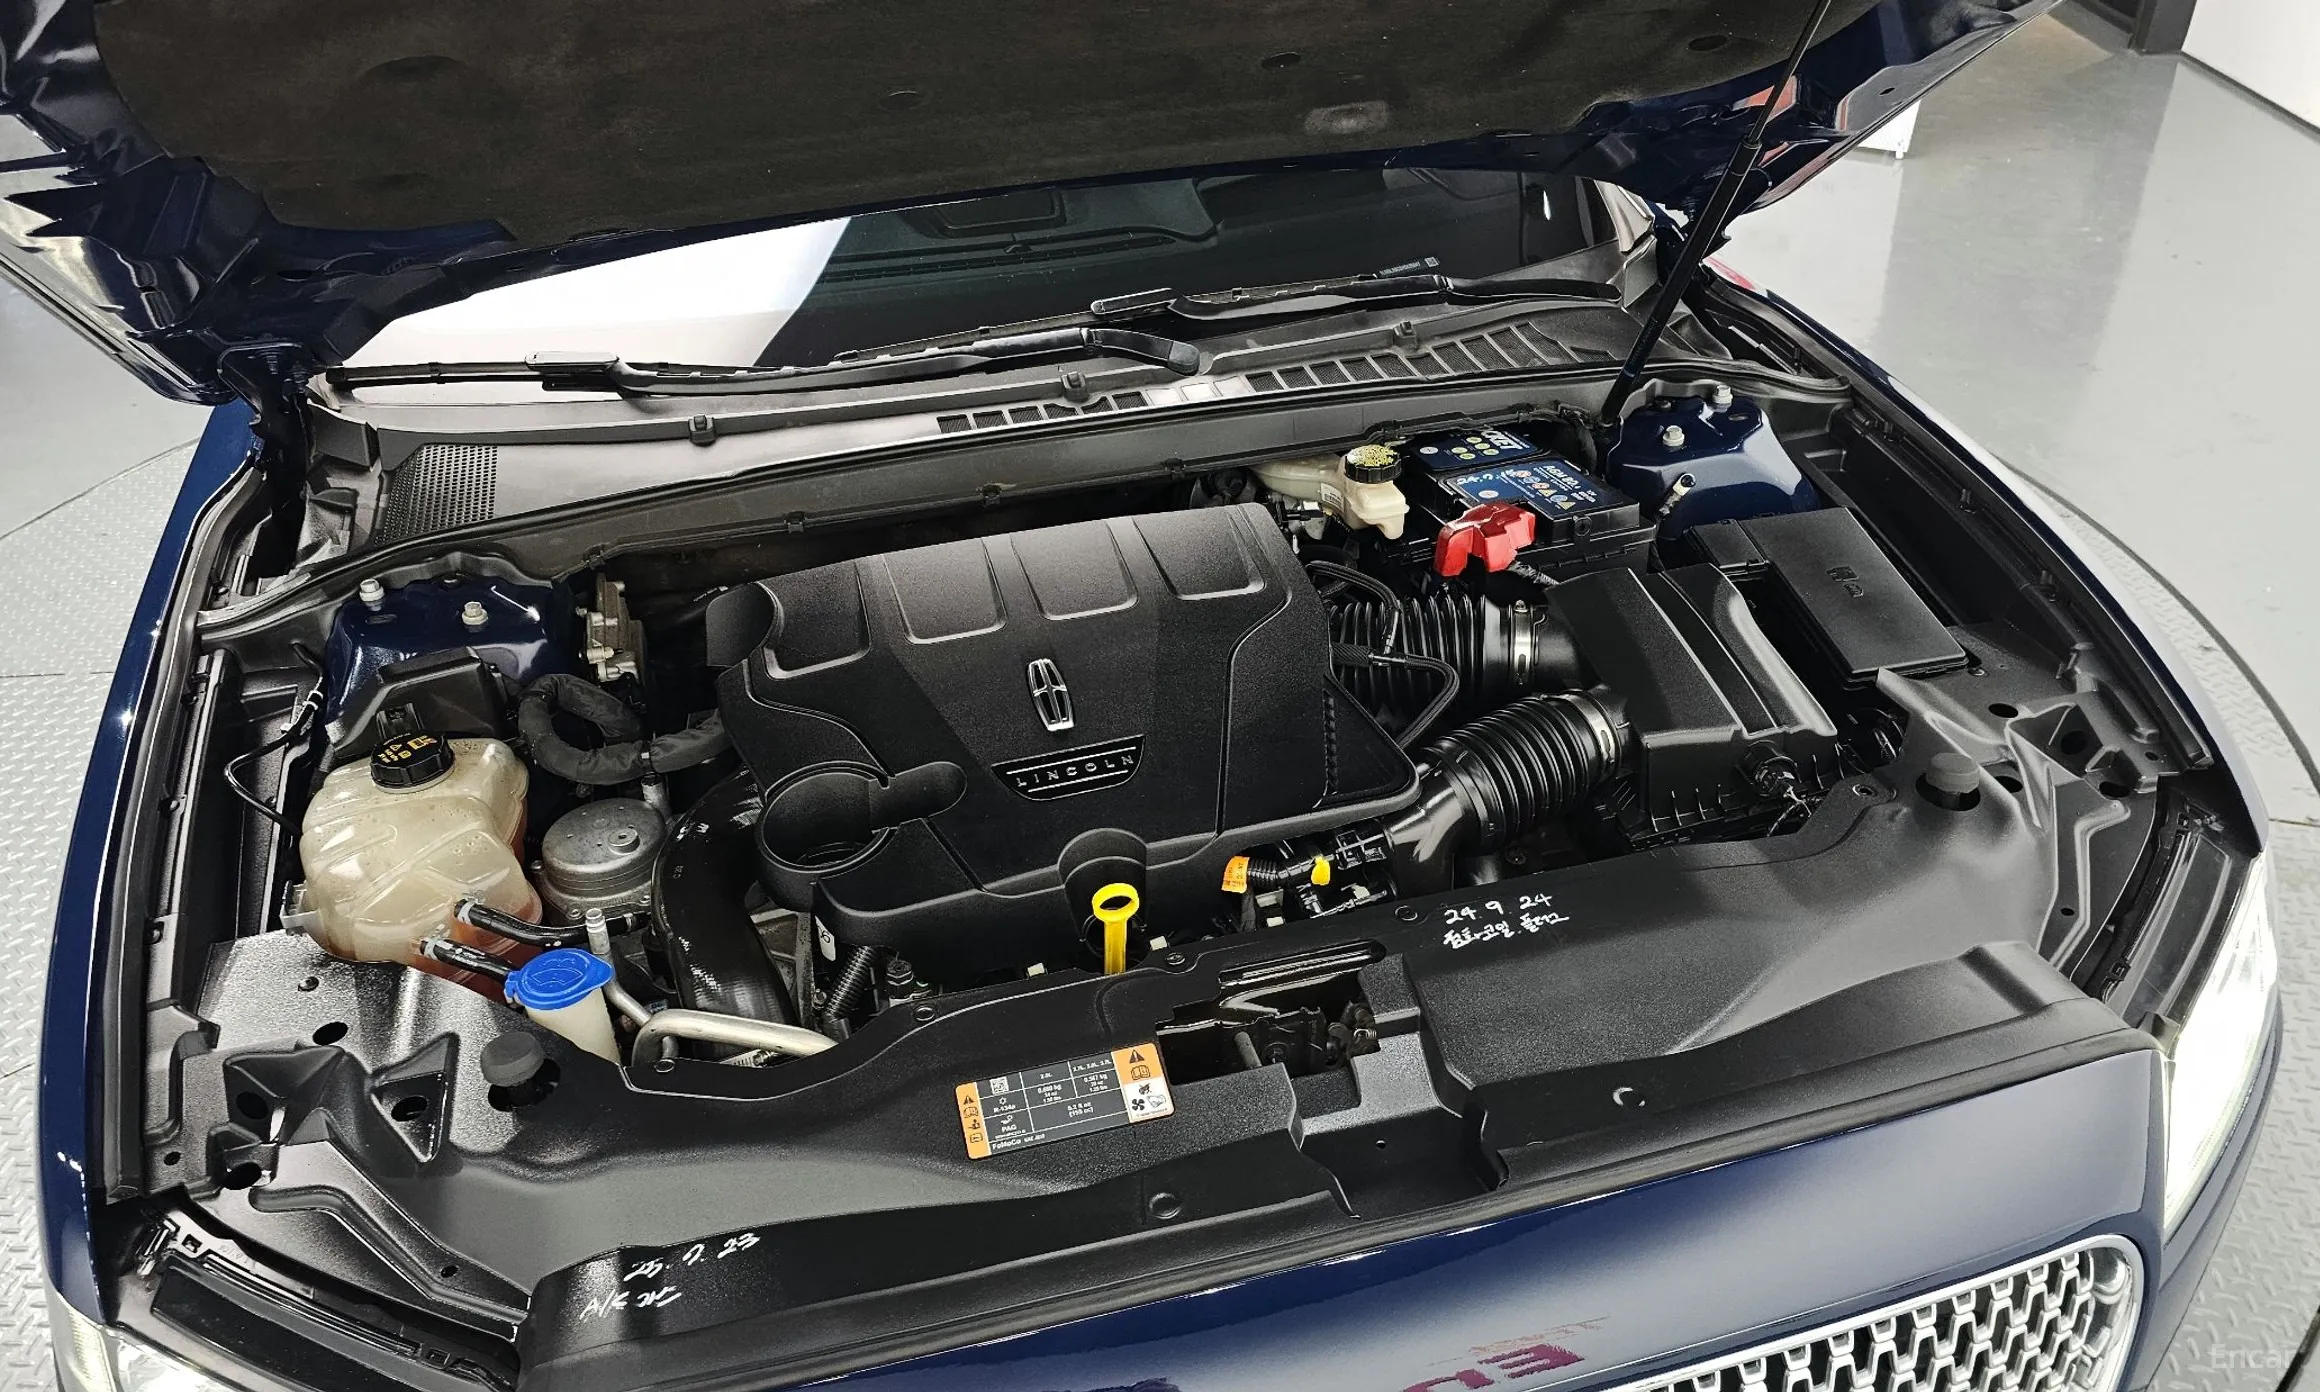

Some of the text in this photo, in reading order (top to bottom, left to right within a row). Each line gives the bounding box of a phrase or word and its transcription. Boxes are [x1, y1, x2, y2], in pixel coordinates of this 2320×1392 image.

[1016, 754, 1134, 788] LINCOLN
[1519, 893, 1552, 910] 24
[1002, 1124, 1017, 1133] PAG
[992, 1138, 1021, 1150] FoMoCo
[717, 1232, 762, 1259] 23
